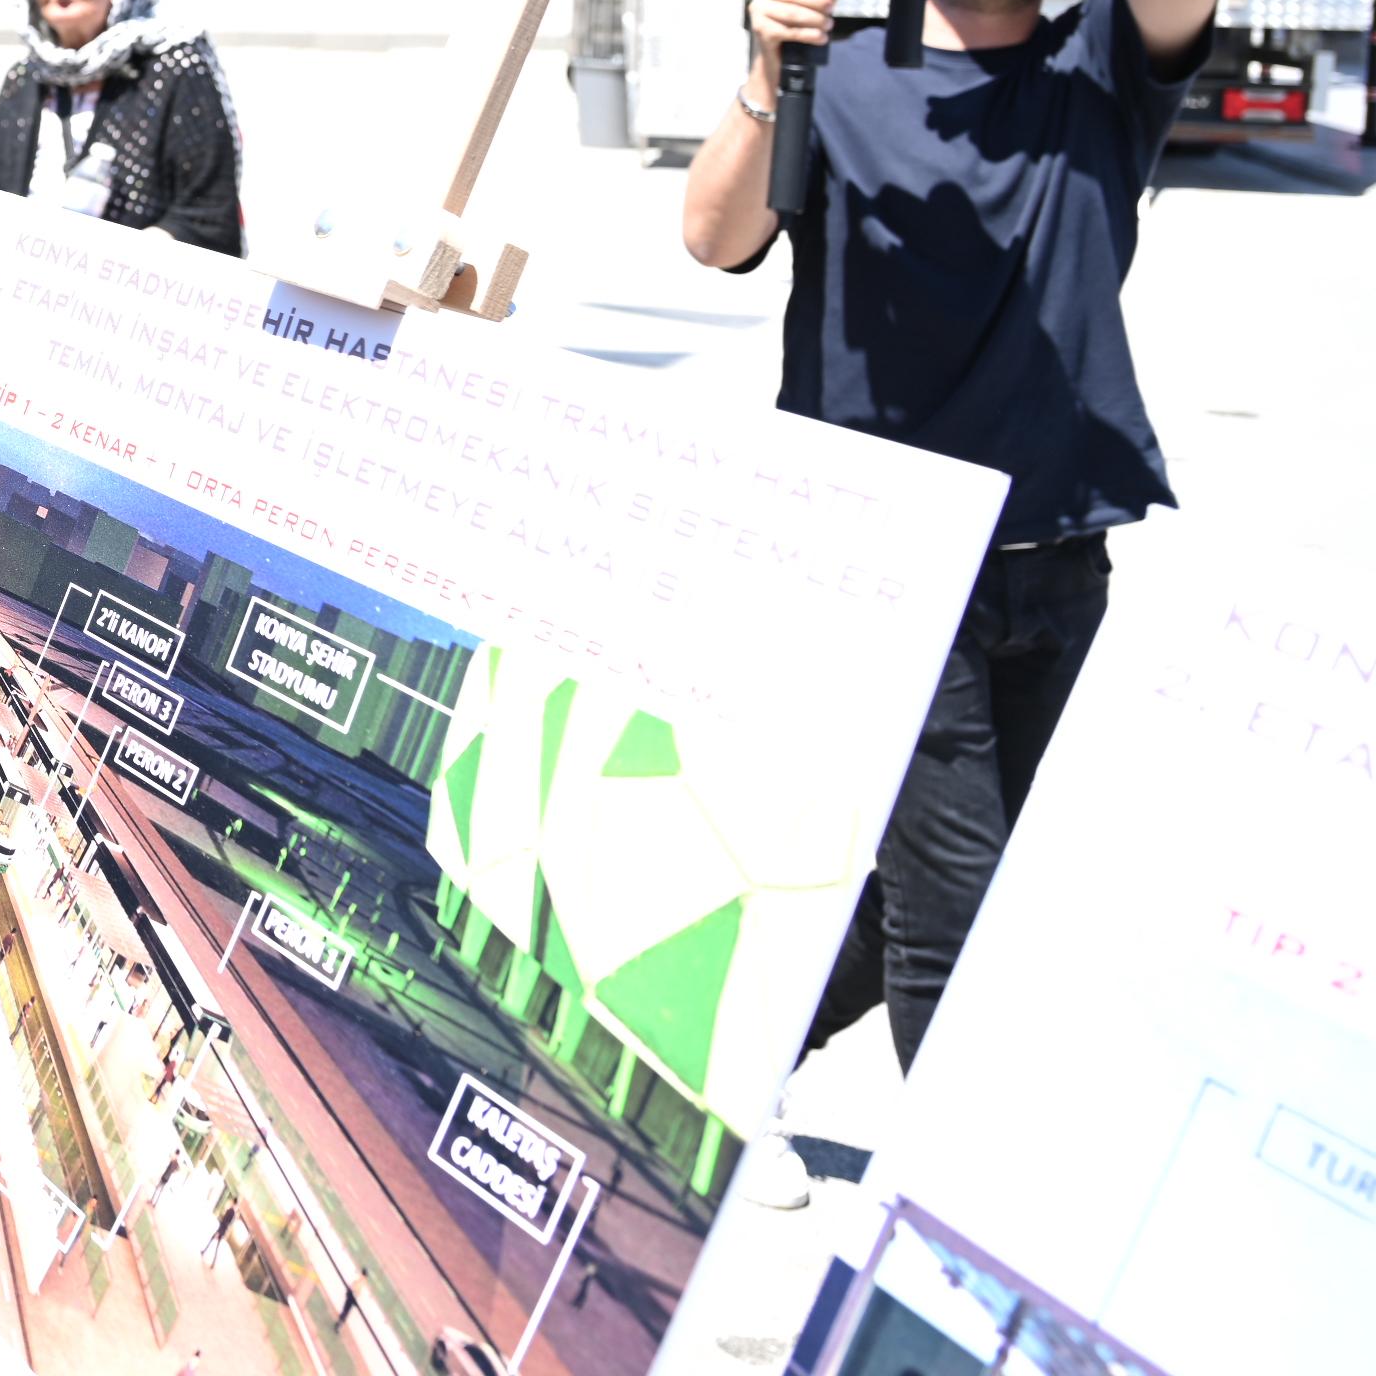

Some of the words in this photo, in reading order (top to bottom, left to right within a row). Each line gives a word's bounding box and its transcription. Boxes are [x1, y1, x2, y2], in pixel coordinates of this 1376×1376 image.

[16, 231, 89, 275] KONYA
[129, 311, 228, 361] İNŞAAT
[237, 354, 272, 387] VE
[134, 373, 246, 434] MONTAJ
[257, 417, 293, 452] VE
[23, 399, 33, 415] 1
[51, 412, 64, 429] 2
[69, 419, 137, 462] KENAR
[186, 470, 243, 509] ORTA
[252, 497, 335, 549] PERON
[117, 621, 174, 662] KANOPİ
[253, 612, 307, 657] KONYA
[306, 638, 358, 681] ŞEHİR
[112, 673, 160, 716] PERON
[159, 702, 173, 722] 3
[247, 649, 339, 710] STADYUMU
[124, 740, 174, 783] PERON
[171, 770, 187, 792] 2
[264, 908, 326, 964] PERON
[321, 947, 338, 974] 1
[467, 1095, 562, 1182] KALETAŞ
[450, 1135, 547, 1219] CADDESİ
